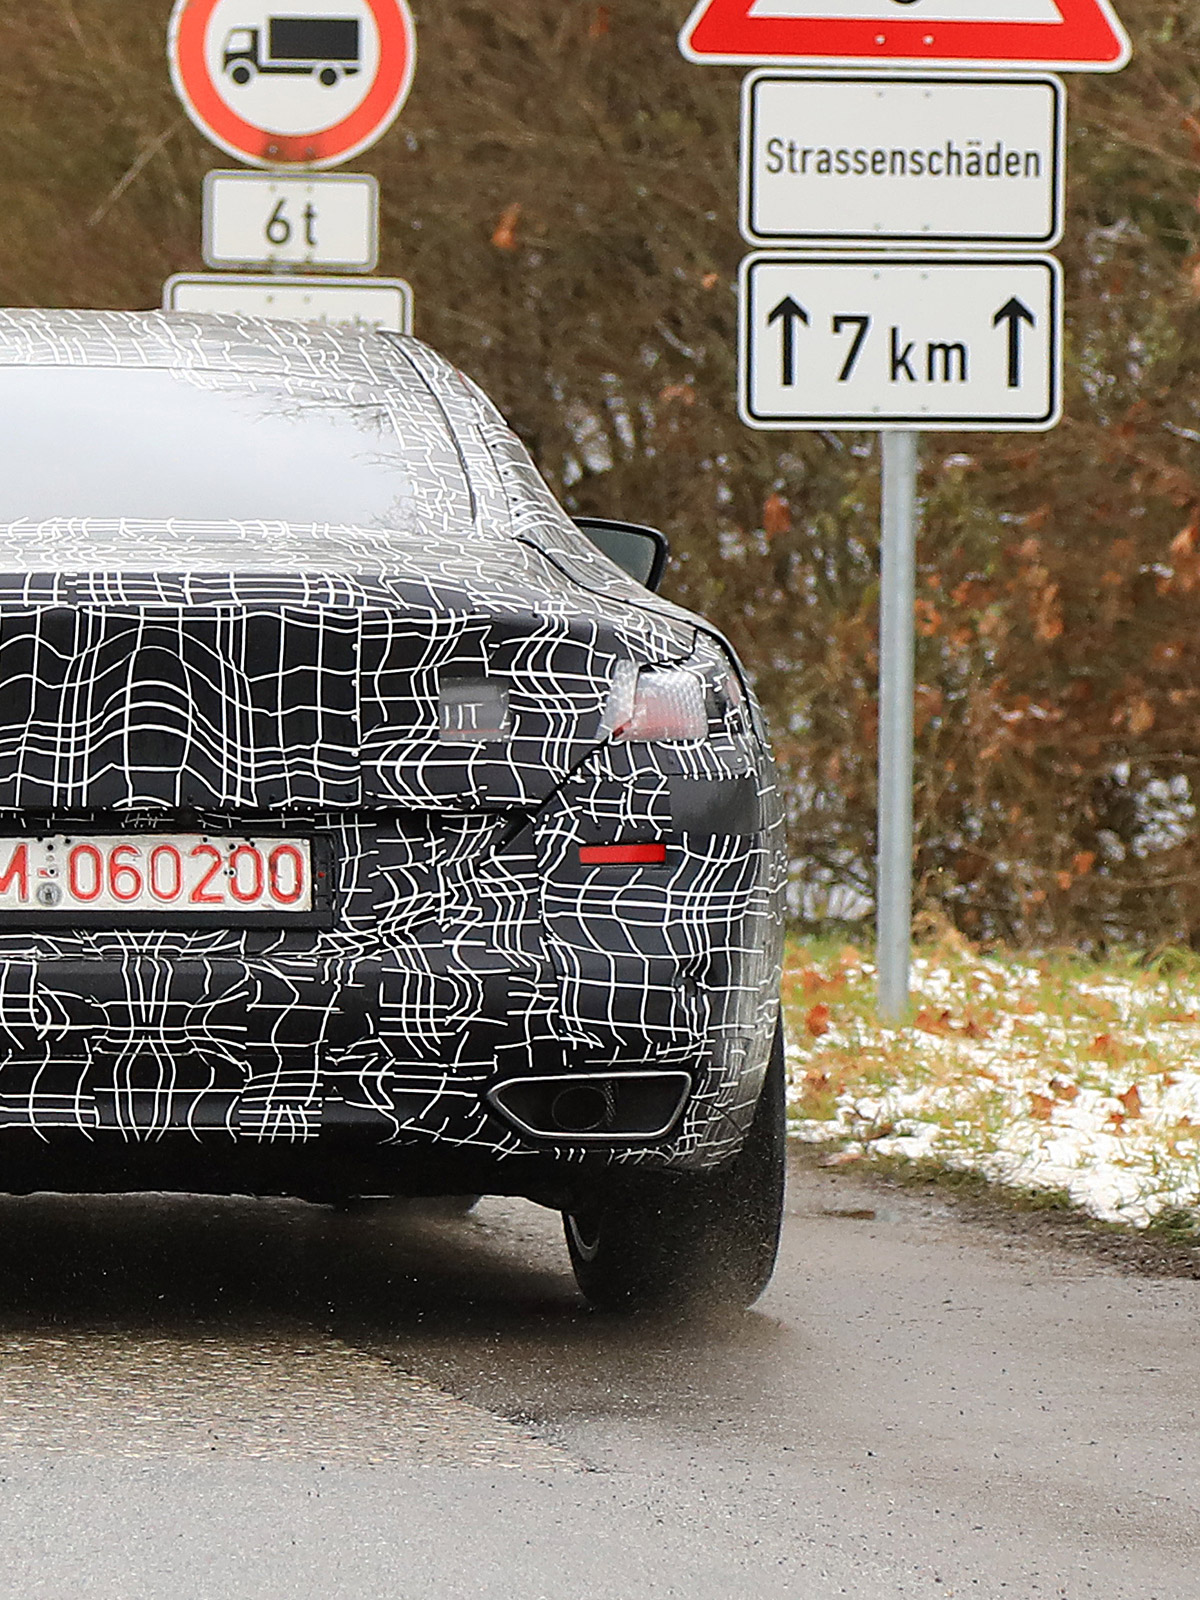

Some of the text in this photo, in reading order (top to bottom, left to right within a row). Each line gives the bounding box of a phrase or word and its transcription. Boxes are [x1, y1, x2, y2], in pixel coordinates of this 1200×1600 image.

[766, 137, 1041, 178] Strassenschäden
[832, 314, 968, 382] 7 km
